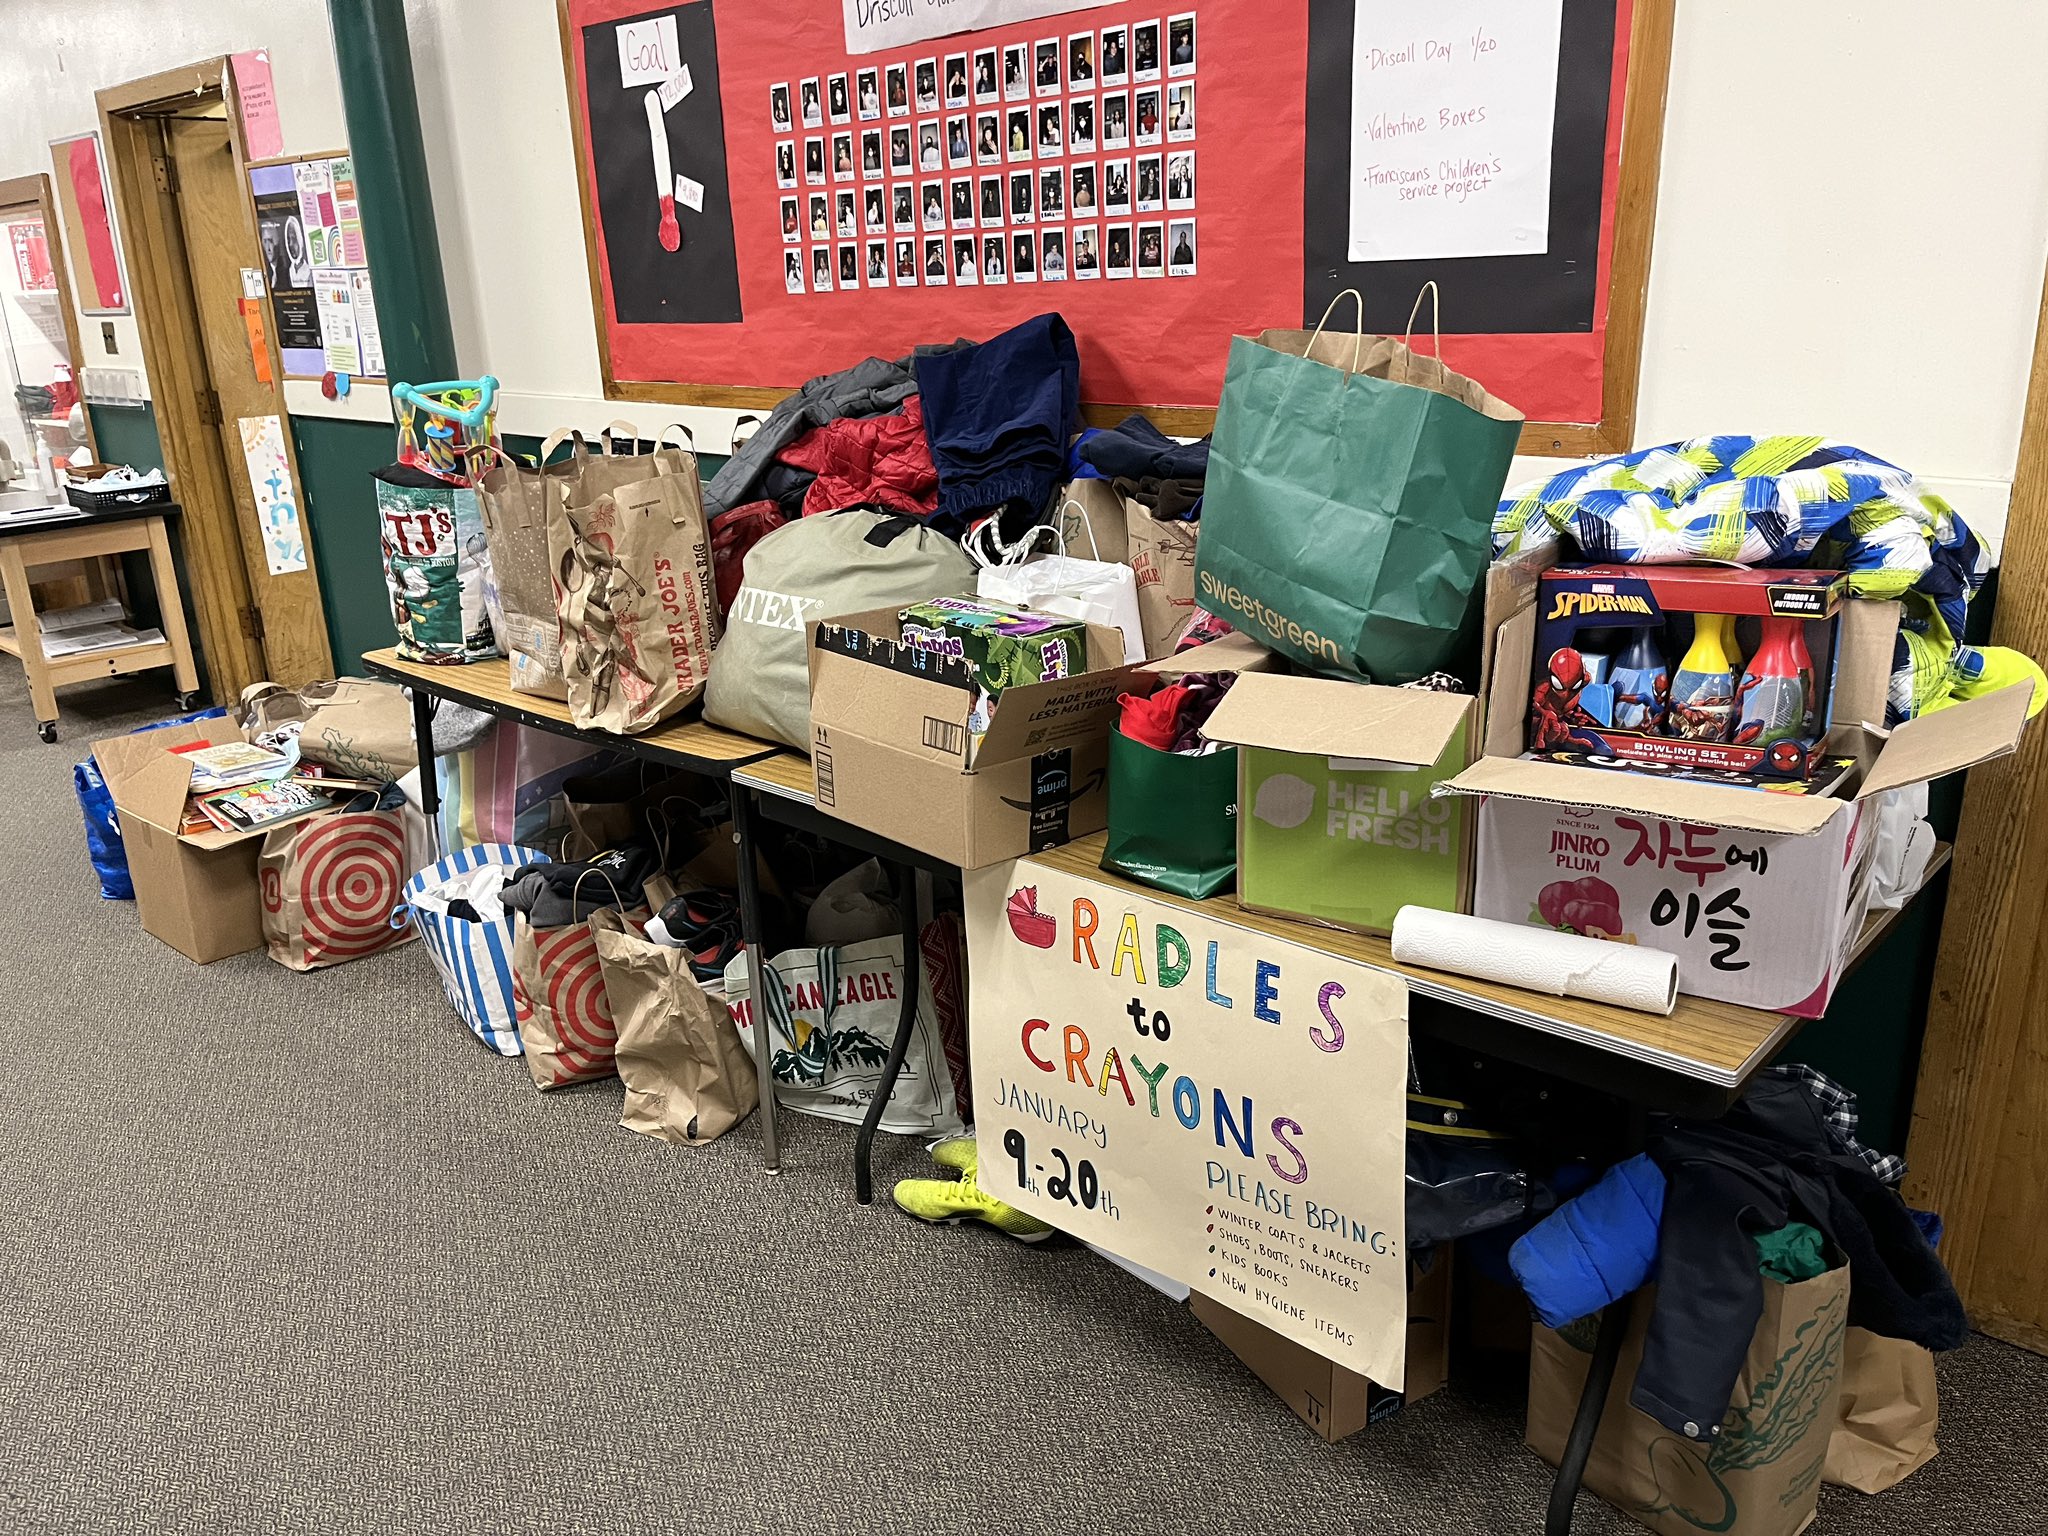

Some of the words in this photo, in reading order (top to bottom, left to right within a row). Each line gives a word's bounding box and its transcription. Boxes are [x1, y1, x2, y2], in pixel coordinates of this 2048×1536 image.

[626, 21, 669, 72] Goal
[1371, 42, 1415, 71] Driscoll
[1425, 40, 1452, 63] Day
[1471, 26, 1497, 62] 1/20
[1367, 112, 1427, 142] Valentine
[1439, 106, 1487, 130] Boxes
[1366, 163, 1431, 189] Franciscans
[1439, 152, 1502, 182] Children's
[1399, 183, 1438, 201] service
[1444, 177, 1492, 203] project
[385, 507, 452, 557] TJ's
[692, 543, 708, 569] BAG
[654, 557, 681, 617] JOE'S
[1773, 600, 1803, 609] OUTDOOR
[1783, 592, 1809, 602] INDOOR
[729, 586, 817, 633] NTEX
[1200, 570, 1341, 665] sweetgreen
[666, 620, 695, 692] TRADER
[1027, 707, 1060, 722] LESS
[1044, 691, 1083, 708] MADE
[1084, 685, 1118, 700] WITH
[1634, 742, 1697, 757] BOWLING
[1700, 750, 1729, 760] SET
[1037, 775, 1068, 795] prime
[1327, 779, 1451, 825] HELLO
[1326, 809, 1450, 855] FRESH
[1548, 830, 1610, 857] JINRO
[1556, 818, 1582, 828] SINCE
[1583, 822, 1600, 831] 1924
[1556, 853, 1600, 873] PLUM
[1614, 816, 1769, 888] 자두에
[1650, 887, 1751, 972] 이슬
[1126, 998, 1172, 1042] to
[993, 1077, 1107, 1149] JANUARY
[1020, 1018, 1309, 1185] CRAYONS
[1206, 1161, 1296, 1220] PLEASE
[1305, 1200, 1397, 1257] BRING:
[1217, 1207, 1262, 1234] WINTER
[1268, 1226, 1305, 1249] COATS
[1312, 1244, 1319, 1254] &
[1322, 1248, 1372, 1275] JACKETS
[1221, 1249, 1247, 1269] KIDS
[1254, 1263, 1289, 1288] BOOKS
[1300, 1258, 1359, 1293] SNEAKERS
[1222, 1272, 1247, 1295] NEW
[1255, 1287, 1306, 1322] HYGIENE
[1315, 1318, 1355, 1347] ITEMS
